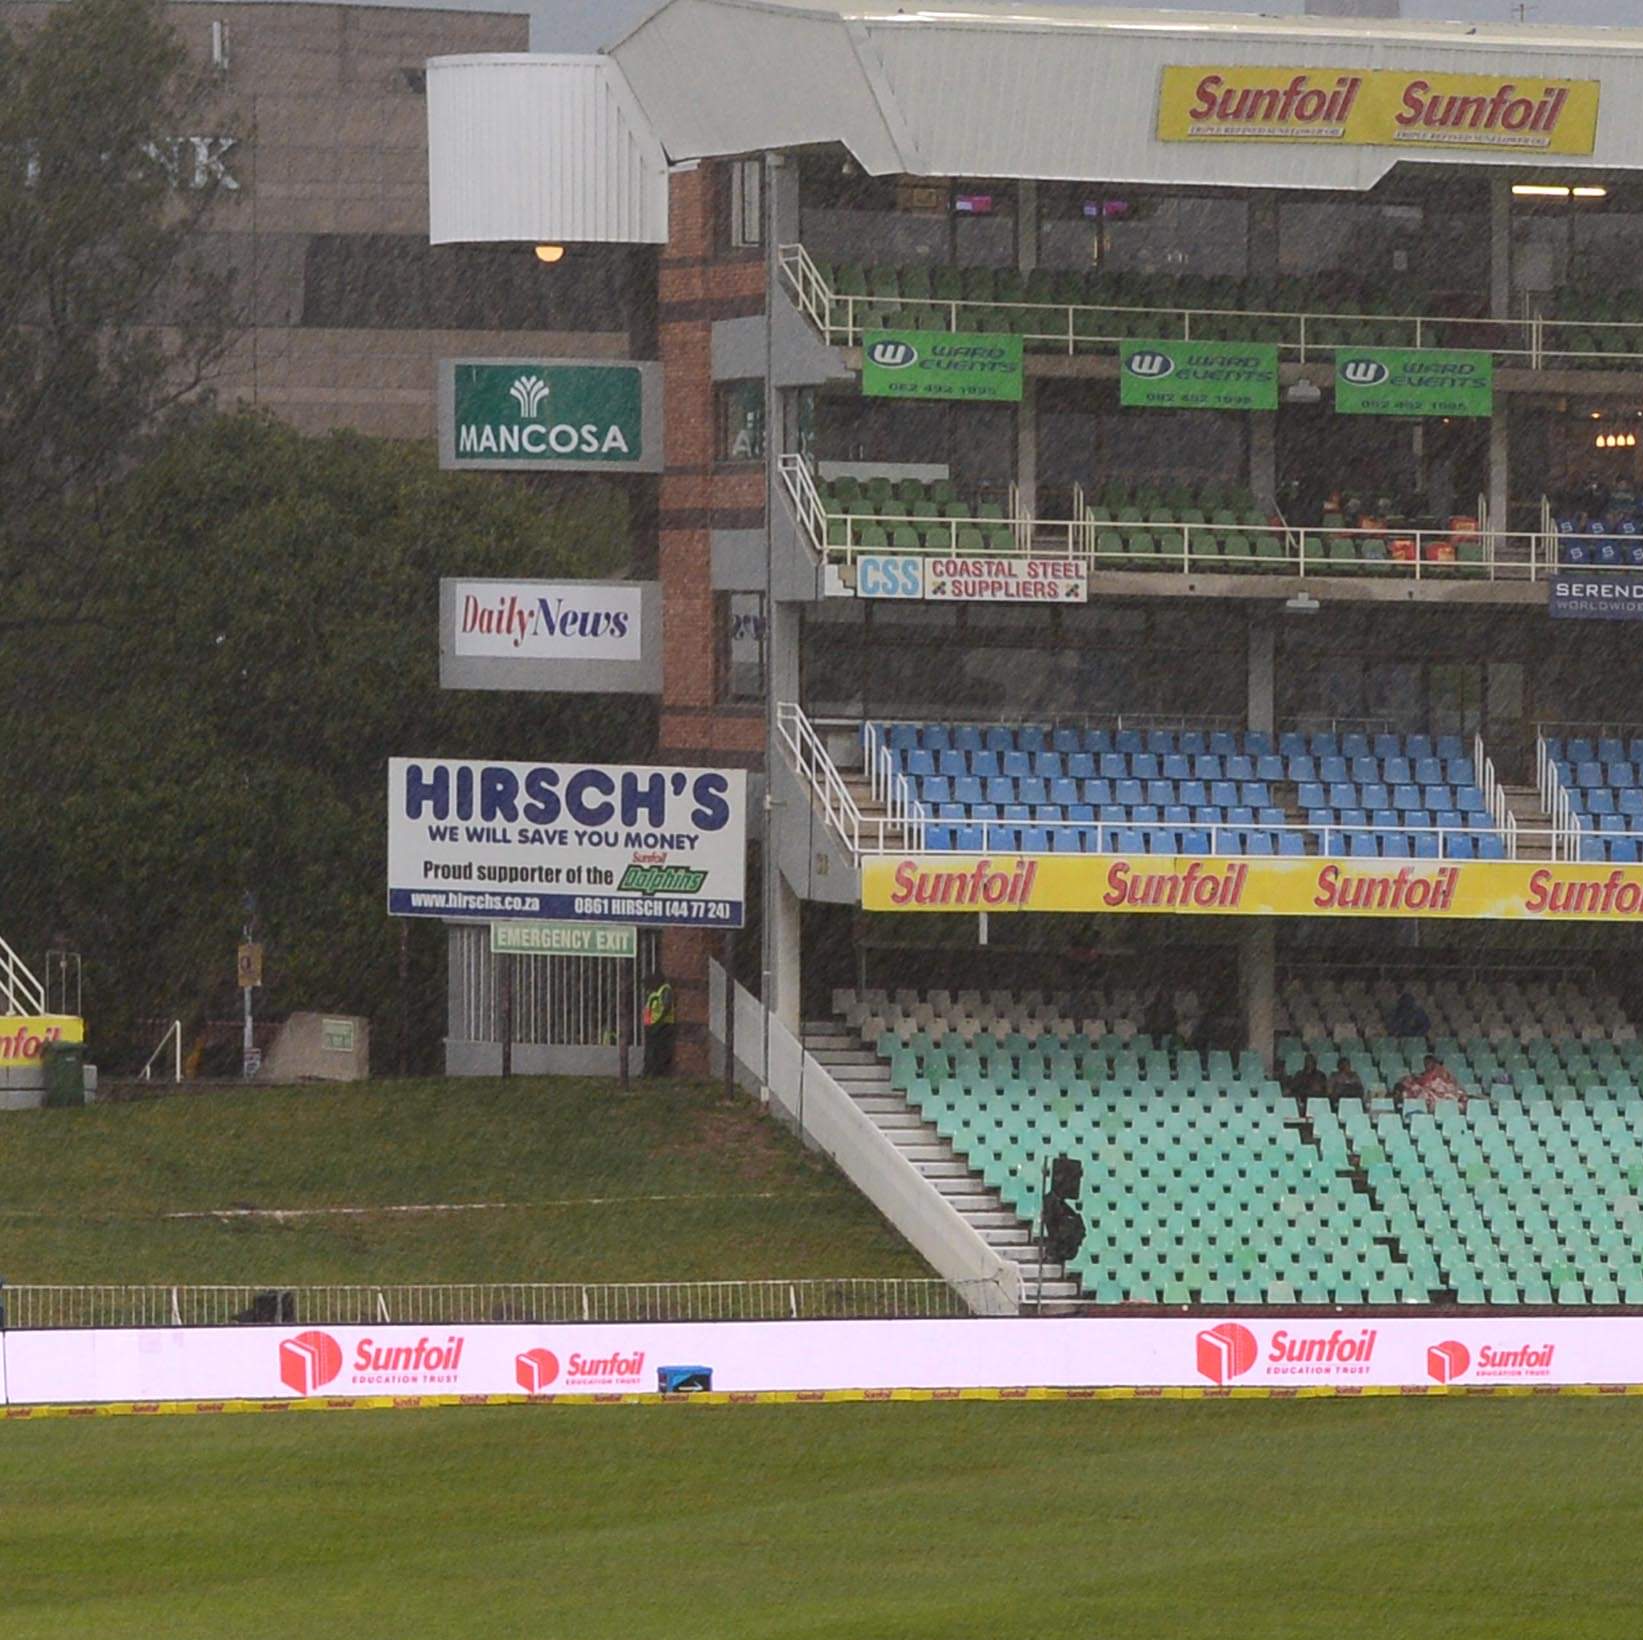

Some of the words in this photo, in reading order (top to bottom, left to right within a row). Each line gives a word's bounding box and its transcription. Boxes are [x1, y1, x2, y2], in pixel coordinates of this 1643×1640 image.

[1189, 75, 1362, 124] Sunfoil
[1395, 80, 1570, 134] Sunfoil
[459, 424, 629, 455] MANCOSA
[860, 558, 919, 596] CSS
[932, 560, 1017, 578] COASTAL
[1027, 561, 1085, 580] STEEL
[951, 580, 1058, 599] SUPPLIERS
[462, 594, 535, 646] Daily
[533, 597, 628, 639] News
[405, 764, 731, 832] HIRSCH'S
[428, 825, 458, 842] WE
[465, 826, 512, 844] WILL
[518, 828, 568, 845] SAVE
[574, 830, 619, 847] YOU
[624, 832, 699, 850] MONEY
[424, 860, 472, 880] Proud
[477, 862, 562, 884] supporter
[566, 864, 583, 884] of
[587, 865, 613, 885] the
[623, 866, 705, 893] Dolphins
[892, 861, 1035, 904] Sunfoil
[1103, 863, 1247, 906] Sunfoil
[1314, 865, 1457, 908] Sunfoil
[411, 892, 540, 912] www.hirschs.co.za
[574, 898, 610, 914] 0861
[611, 899, 663, 916] HIRSCH
[665, 900, 688, 918] (44
[689, 902, 707, 918] 77
[708, 902, 730, 920] 24)
[500, 927, 591, 949] EMERGENCY
[597, 930, 629, 951] EXIT
[353, 1336, 465, 1372] Sunfoil
[1268, 1329, 1377, 1364] Sunfoil
[1477, 1344, 1555, 1369] Sunfoil
[567, 1351, 645, 1376] Sunfoil
[1266, 1367, 1331, 1375] EDUCATION
[1336, 1366, 1371, 1374] TRUST
[352, 1375, 424, 1385] EDUCATION
[427, 1374, 464, 1384] TRUST
